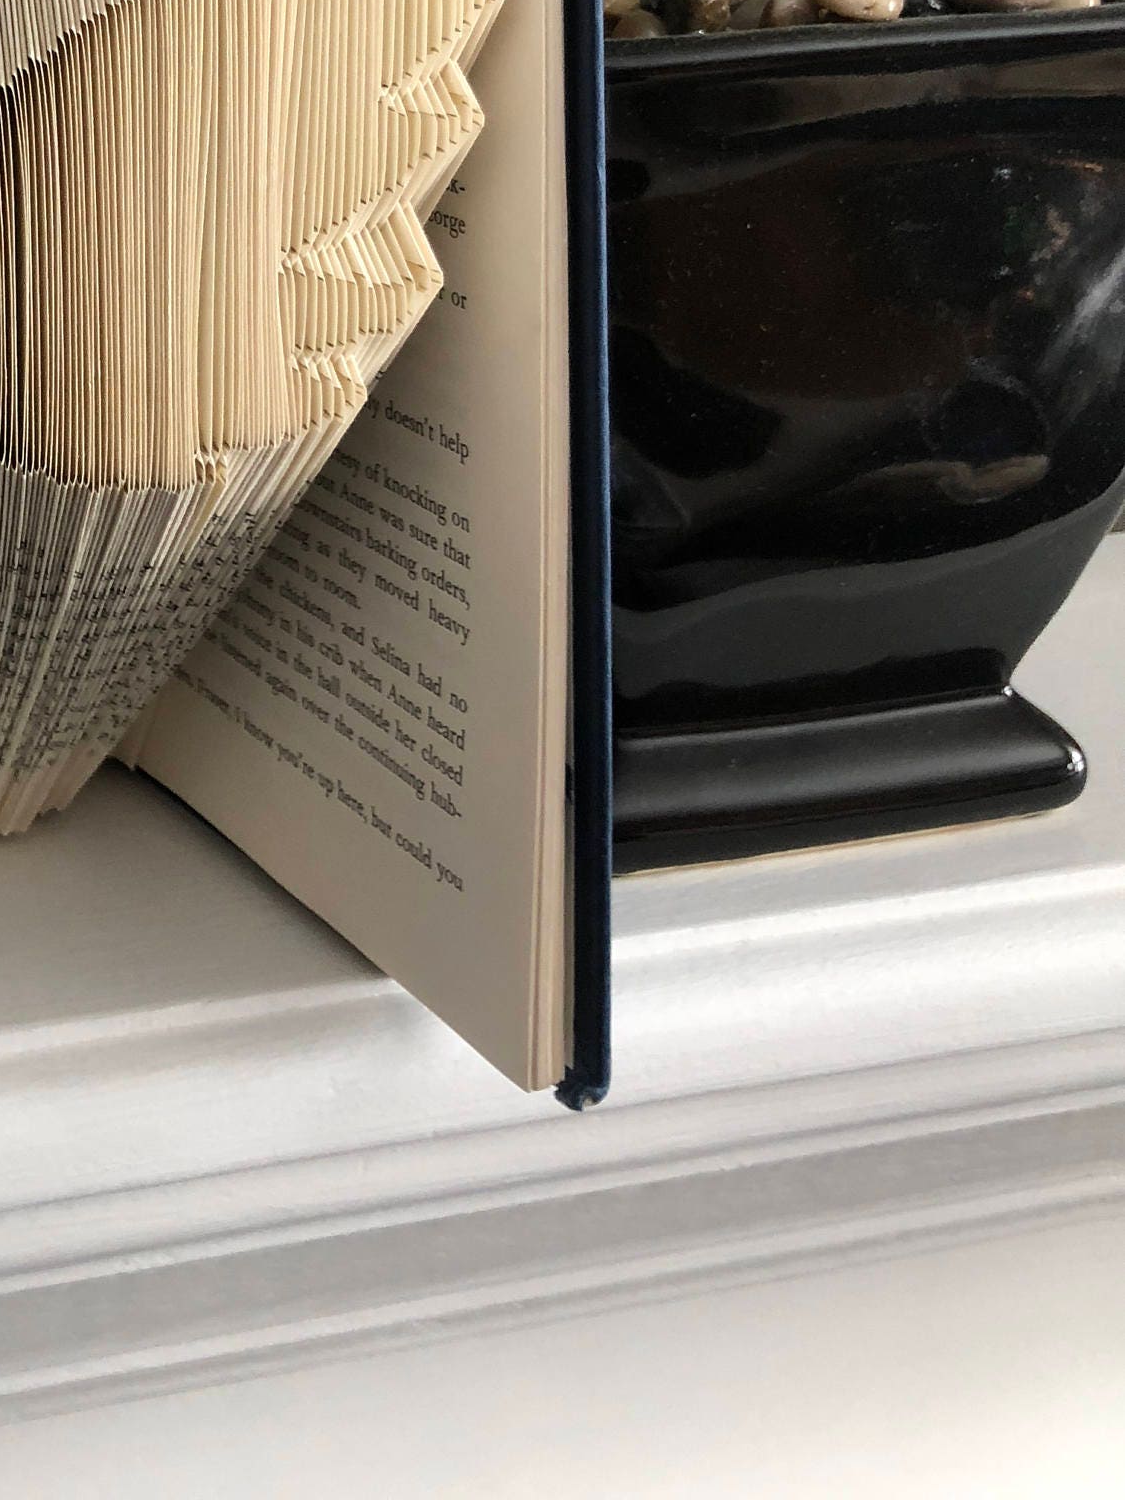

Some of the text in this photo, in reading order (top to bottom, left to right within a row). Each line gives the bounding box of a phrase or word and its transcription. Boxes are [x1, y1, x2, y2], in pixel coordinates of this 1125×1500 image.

[450, 291, 467, 310] or
[384, 399, 434, 441] doesn't
[438, 424, 470, 466] help
[339, 484, 375, 516] Anne
[379, 507, 406, 532] was
[408, 523, 439, 551] sure
[442, 537, 472, 570] that
[364, 463, 381, 483] of
[383, 467, 447, 526] knocking
[451, 512, 470, 533] on
[304, 565, 318, 583] to
[323, 577, 362, 610] room.
[315, 540, 331, 558] as
[338, 548, 367, 583] they
[374, 574, 420, 611] moved
[428, 599, 471, 646] heavy
[365, 527, 418, 581] barking
[421, 566, 471, 611] orders,
[279, 580, 335, 632] chickens,
[340, 622, 365, 646] and
[371, 636, 411, 677] Selina
[417, 662, 442, 698] had
[448, 693, 468, 713] no
[279, 616, 466, 751] in his crib when Anne heard
[265, 672, 298, 702] again
[301, 696, 330, 724] over
[334, 713, 355, 741] the
[358, 736, 426, 801] continuing
[430, 780, 463, 818] hub-
[275, 641, 289, 664] in
[293, 652, 313, 680] the
[317, 665, 341, 698] hall
[345, 692, 391, 733] outside
[394, 719, 417, 752] her
[421, 743, 463, 787] closed
[243, 710, 274, 748] know
[277, 741, 315, 779] you're
[316, 772, 335, 799] up
[337, 779, 368, 824] here,
[371, 805, 392, 839] but
[395, 832, 432, 870] could
[436, 862, 464, 893] you
